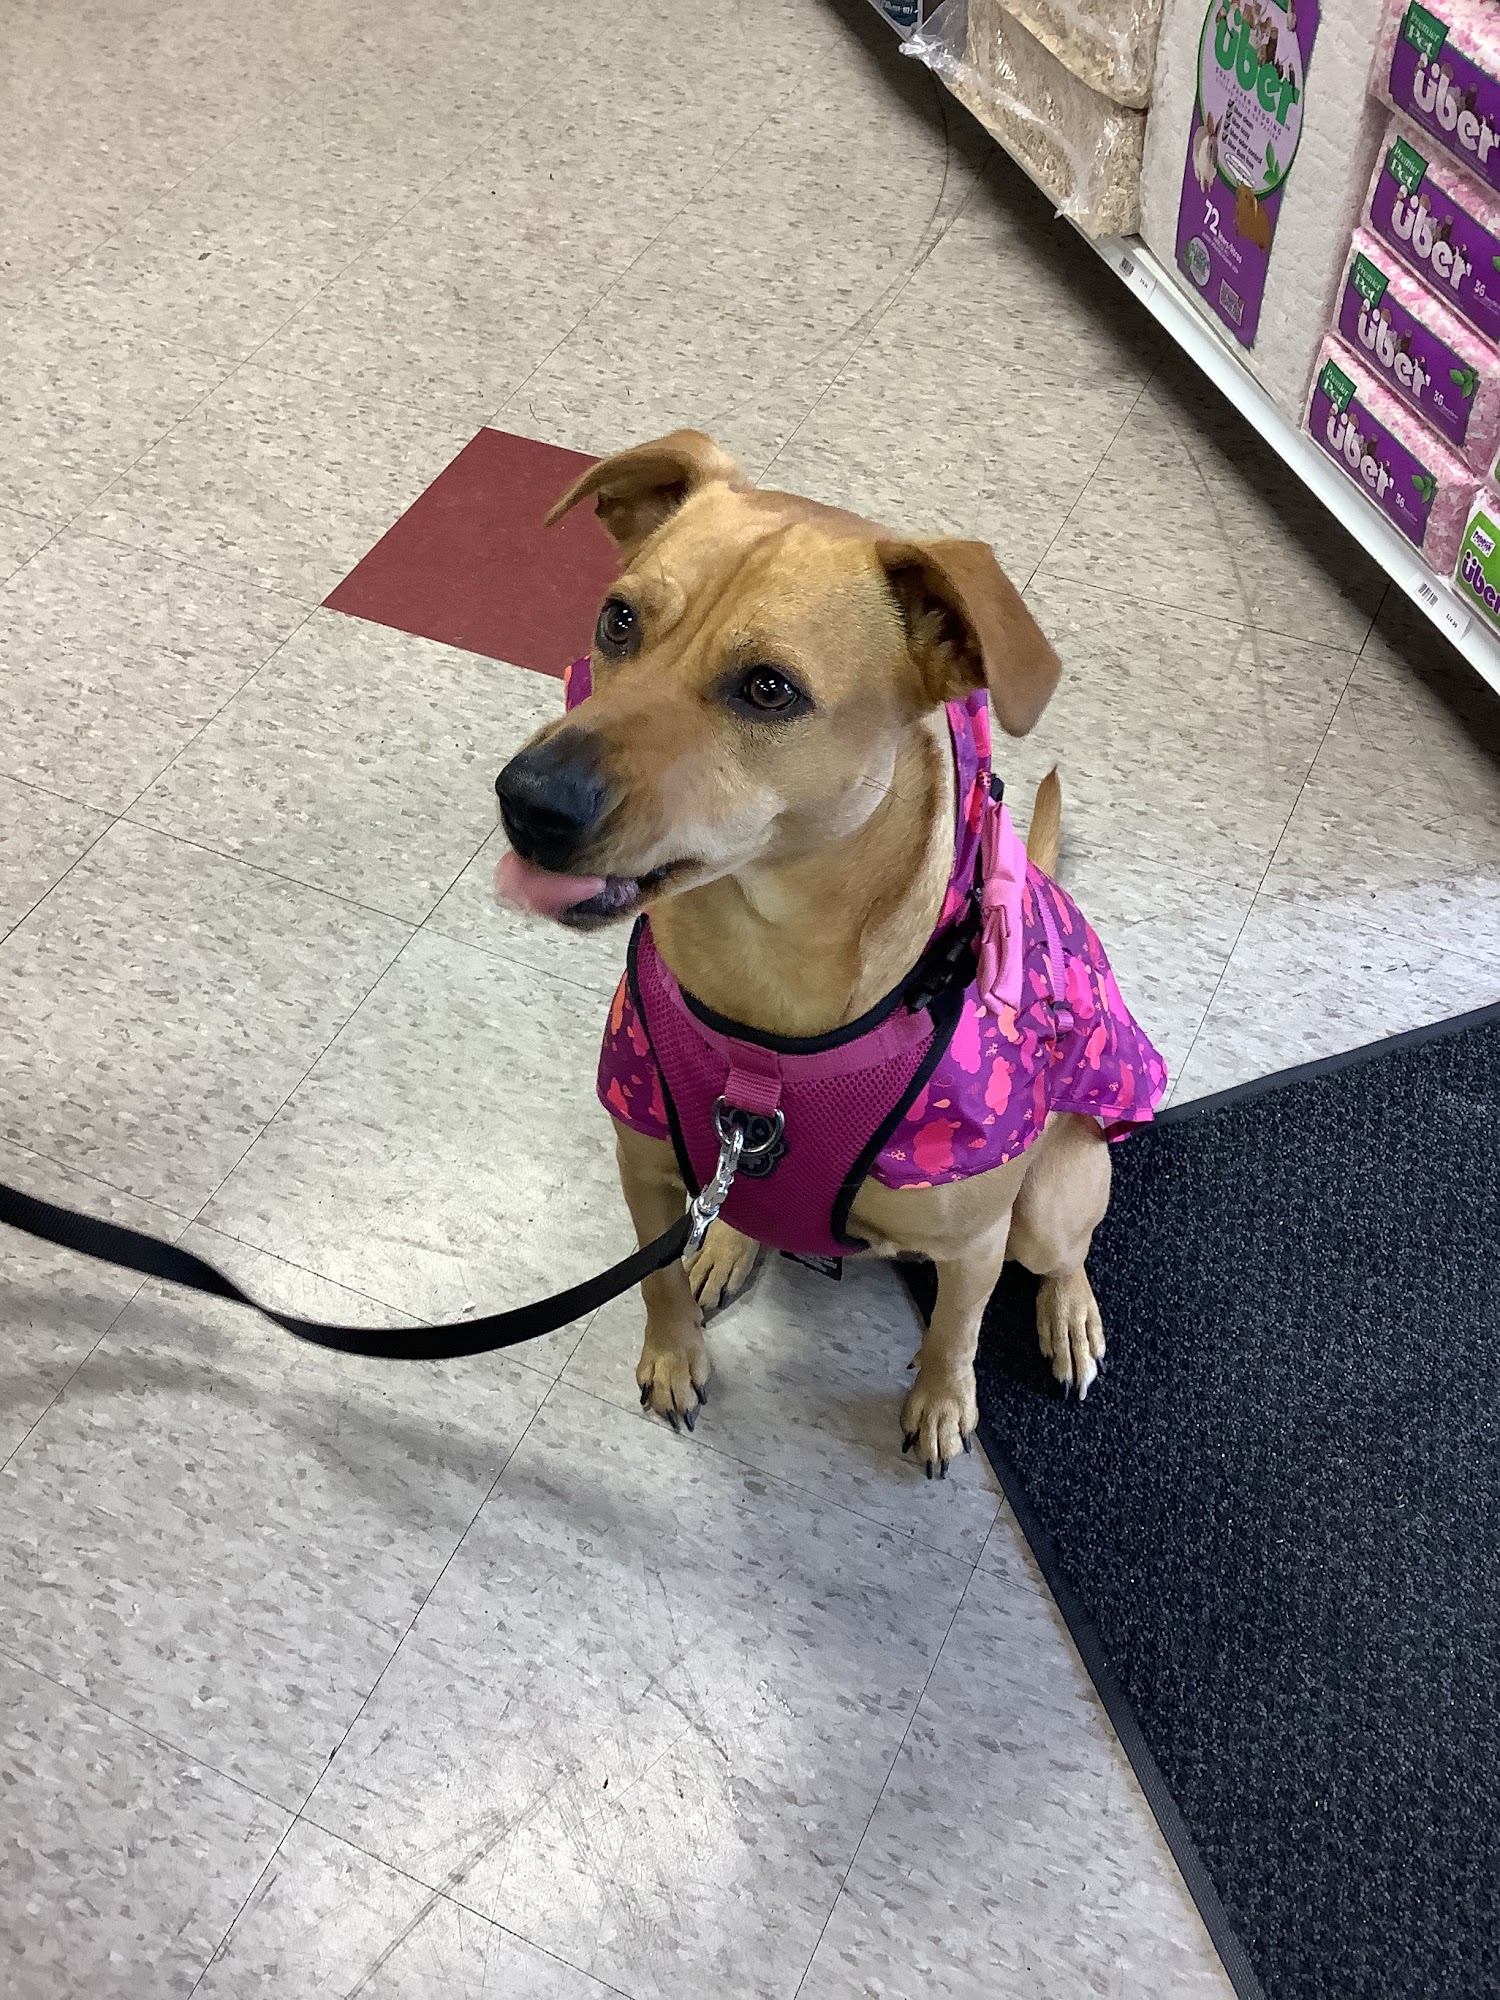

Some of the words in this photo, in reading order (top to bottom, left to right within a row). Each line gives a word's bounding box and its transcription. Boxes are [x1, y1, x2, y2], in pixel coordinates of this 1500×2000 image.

[1407, 24, 1433, 57] Pet
[1409, 11, 1440, 42] Premier
[1214, 0, 1300, 126] über
[1413, 52, 1500, 163] über
[1390, 158, 1413, 190] Pet
[1393, 145, 1421, 176] Premier
[1203, 198, 1220, 235] 72
[1391, 184, 1472, 290] über
[1354, 274, 1375, 303] Pet
[1356, 262, 1382, 292] Premier
[1473, 279, 1486, 297] 36
[1357, 299, 1431, 398] über
[1323, 379, 1343, 408] Pet
[1326, 367, 1350, 396] Premier
[1433, 389, 1444, 406] 36
[1326, 402, 1395, 499] über
[1395, 492, 1406, 508] 36
